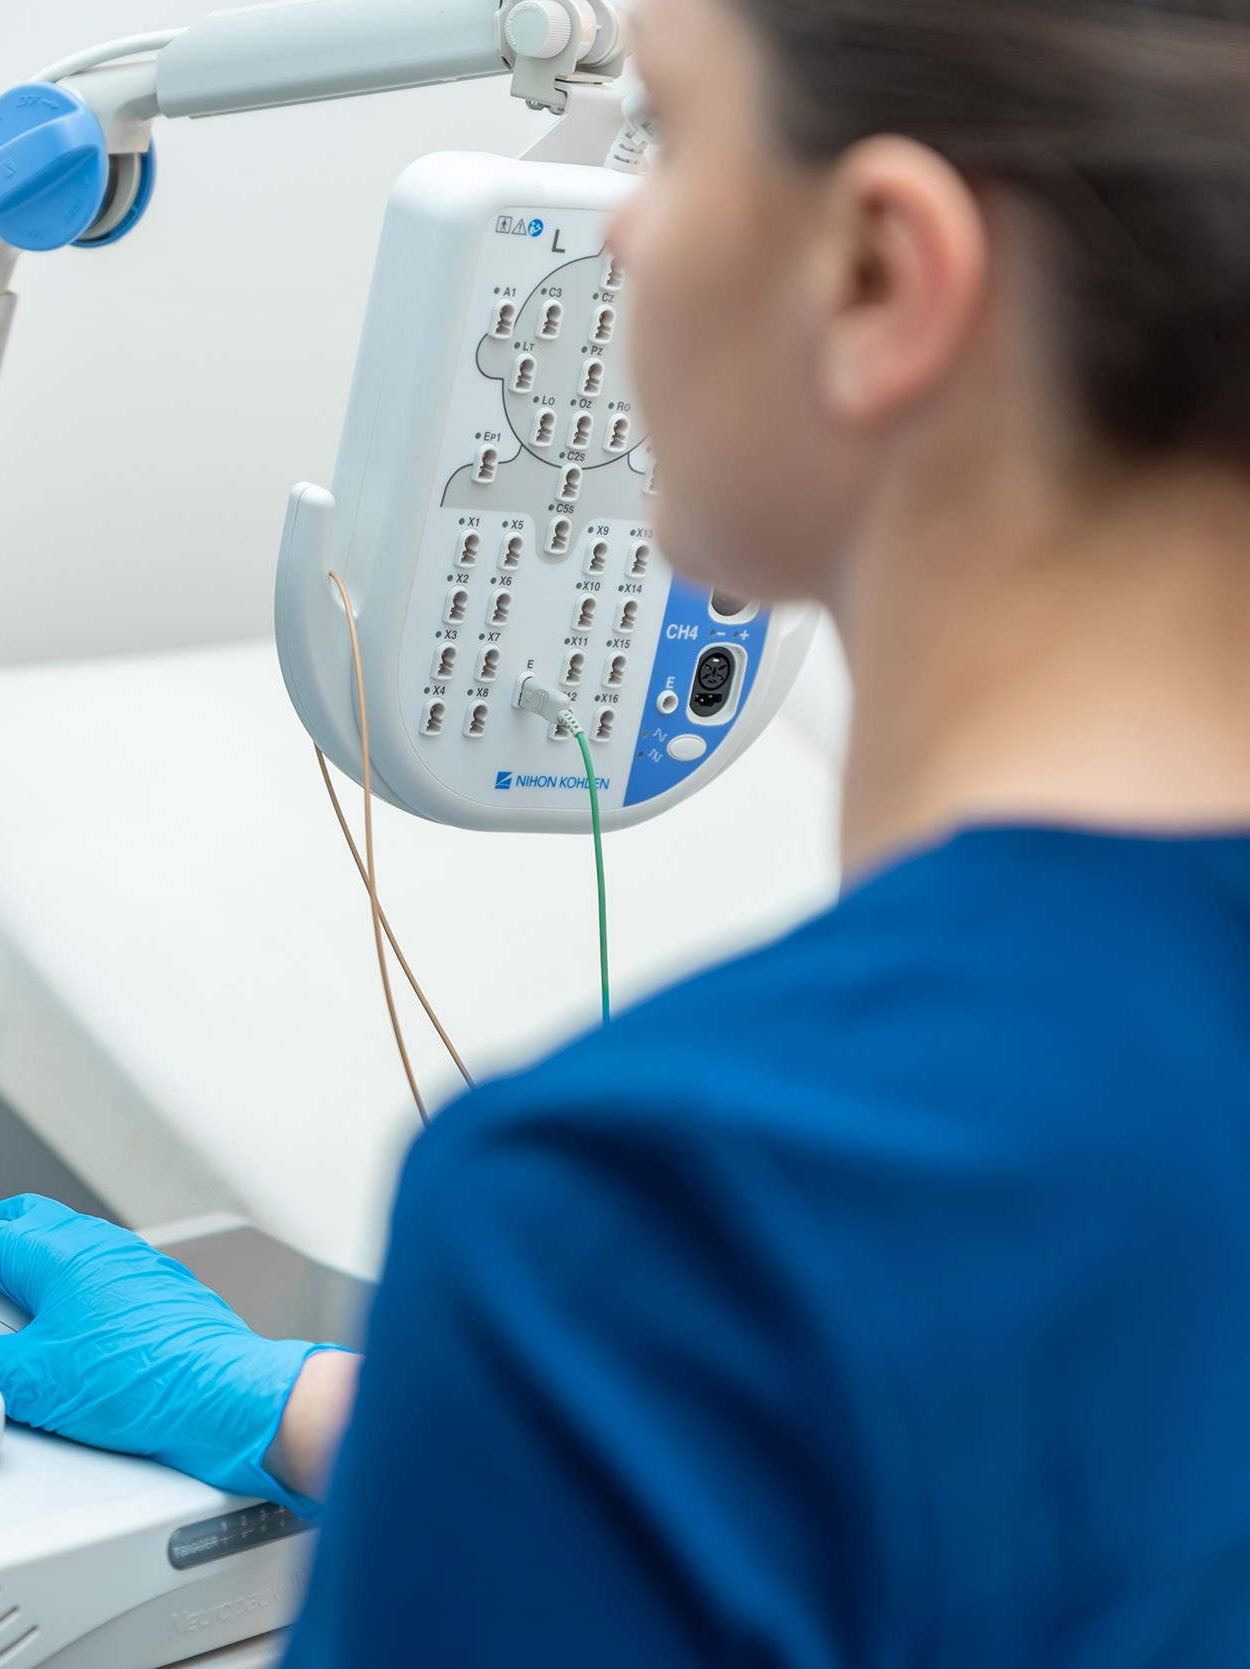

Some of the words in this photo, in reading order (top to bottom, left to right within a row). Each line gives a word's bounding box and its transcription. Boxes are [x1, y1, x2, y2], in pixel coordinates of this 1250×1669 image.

[551, 229, 566, 253] L
[503, 287, 517, 297] A1
[548, 287, 562, 298] C3
[467, 516, 480, 527] X1
[510, 519, 524, 530] X5
[596, 526, 610, 536] X9
[635, 528, 654, 538] X13
[455, 573, 469, 584] X2
[499, 575, 512, 586] X6
[581, 581, 601, 591] X10
[624, 583, 643, 594] X14
[444, 630, 458, 640] X3
[666, 623, 699, 640] CH4
[487, 632, 501, 642] X7
[570, 637, 588, 646] X11
[612, 638, 631, 649] X15
[527, 659, 534, 669] E
[665, 676, 675, 689] E
[432, 686, 446, 695] X4
[475, 687, 489, 697] X8
[599, 693, 619, 703] X16
[515, 774, 558, 788] NIHON
